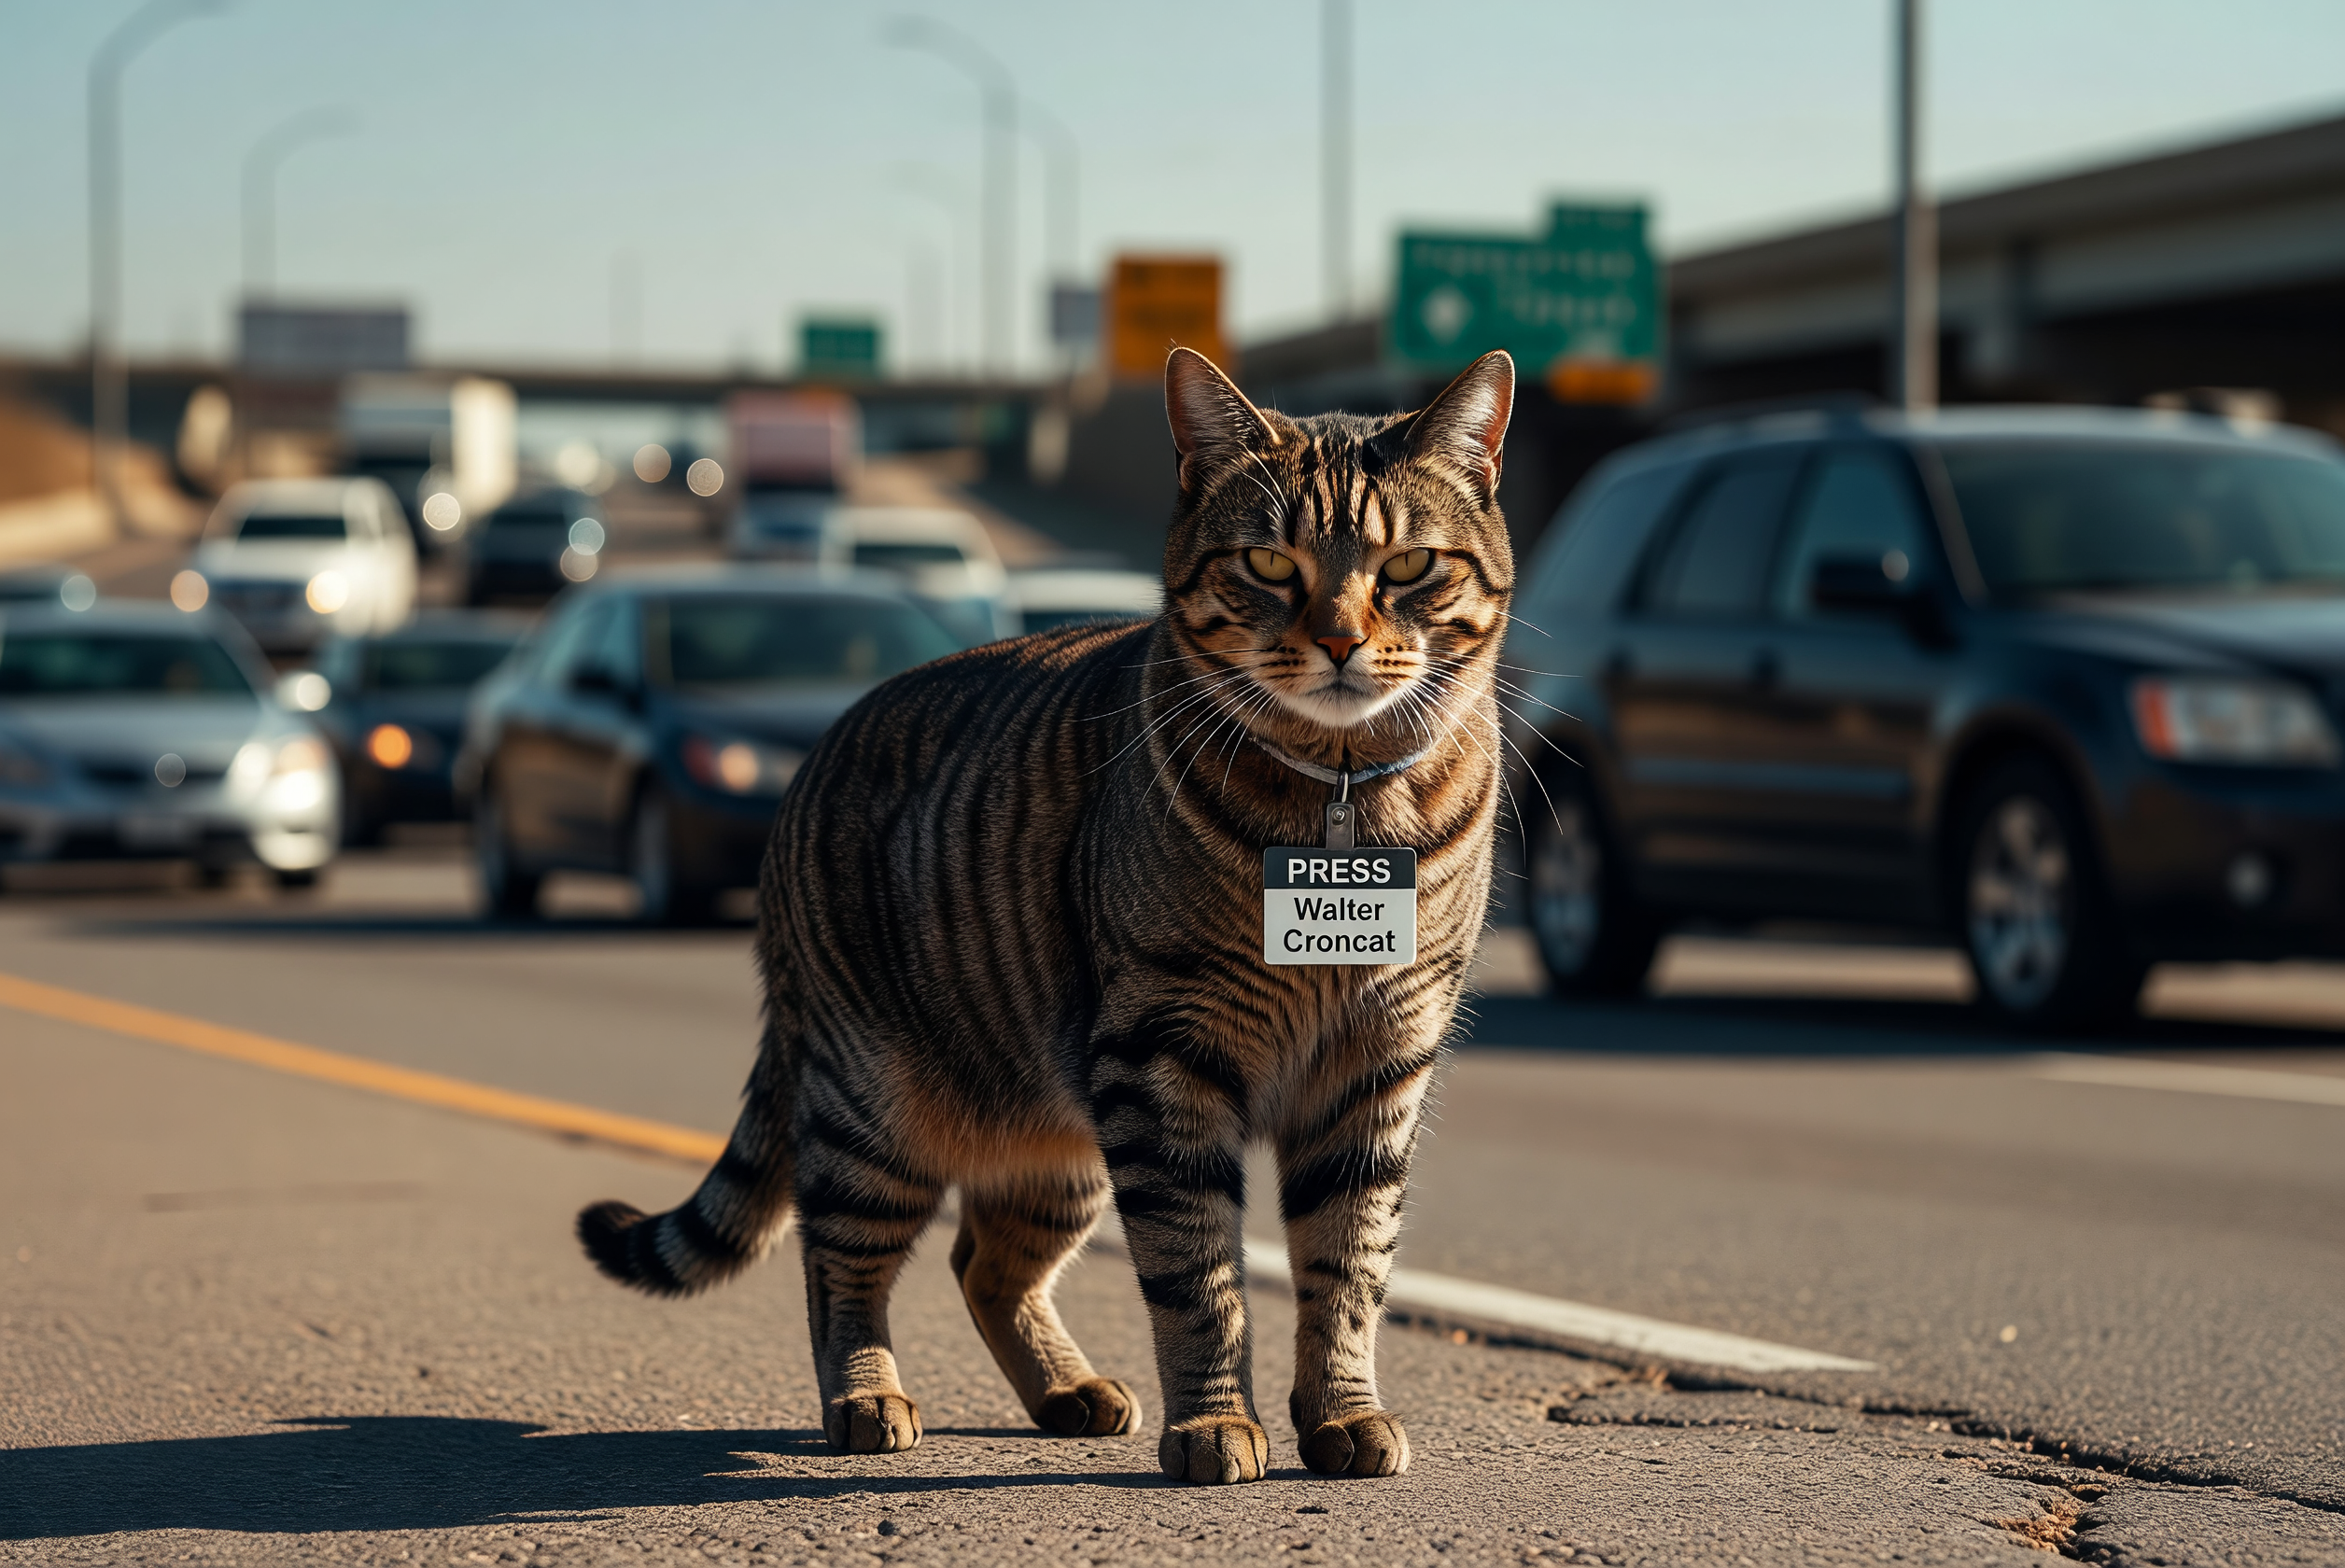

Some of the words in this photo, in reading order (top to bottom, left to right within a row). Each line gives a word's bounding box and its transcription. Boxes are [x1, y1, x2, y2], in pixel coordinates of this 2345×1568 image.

[1288, 858, 1391, 884] PRESS
[1294, 897, 1385, 921] Walter
[1284, 929, 1397, 953] Croncat
